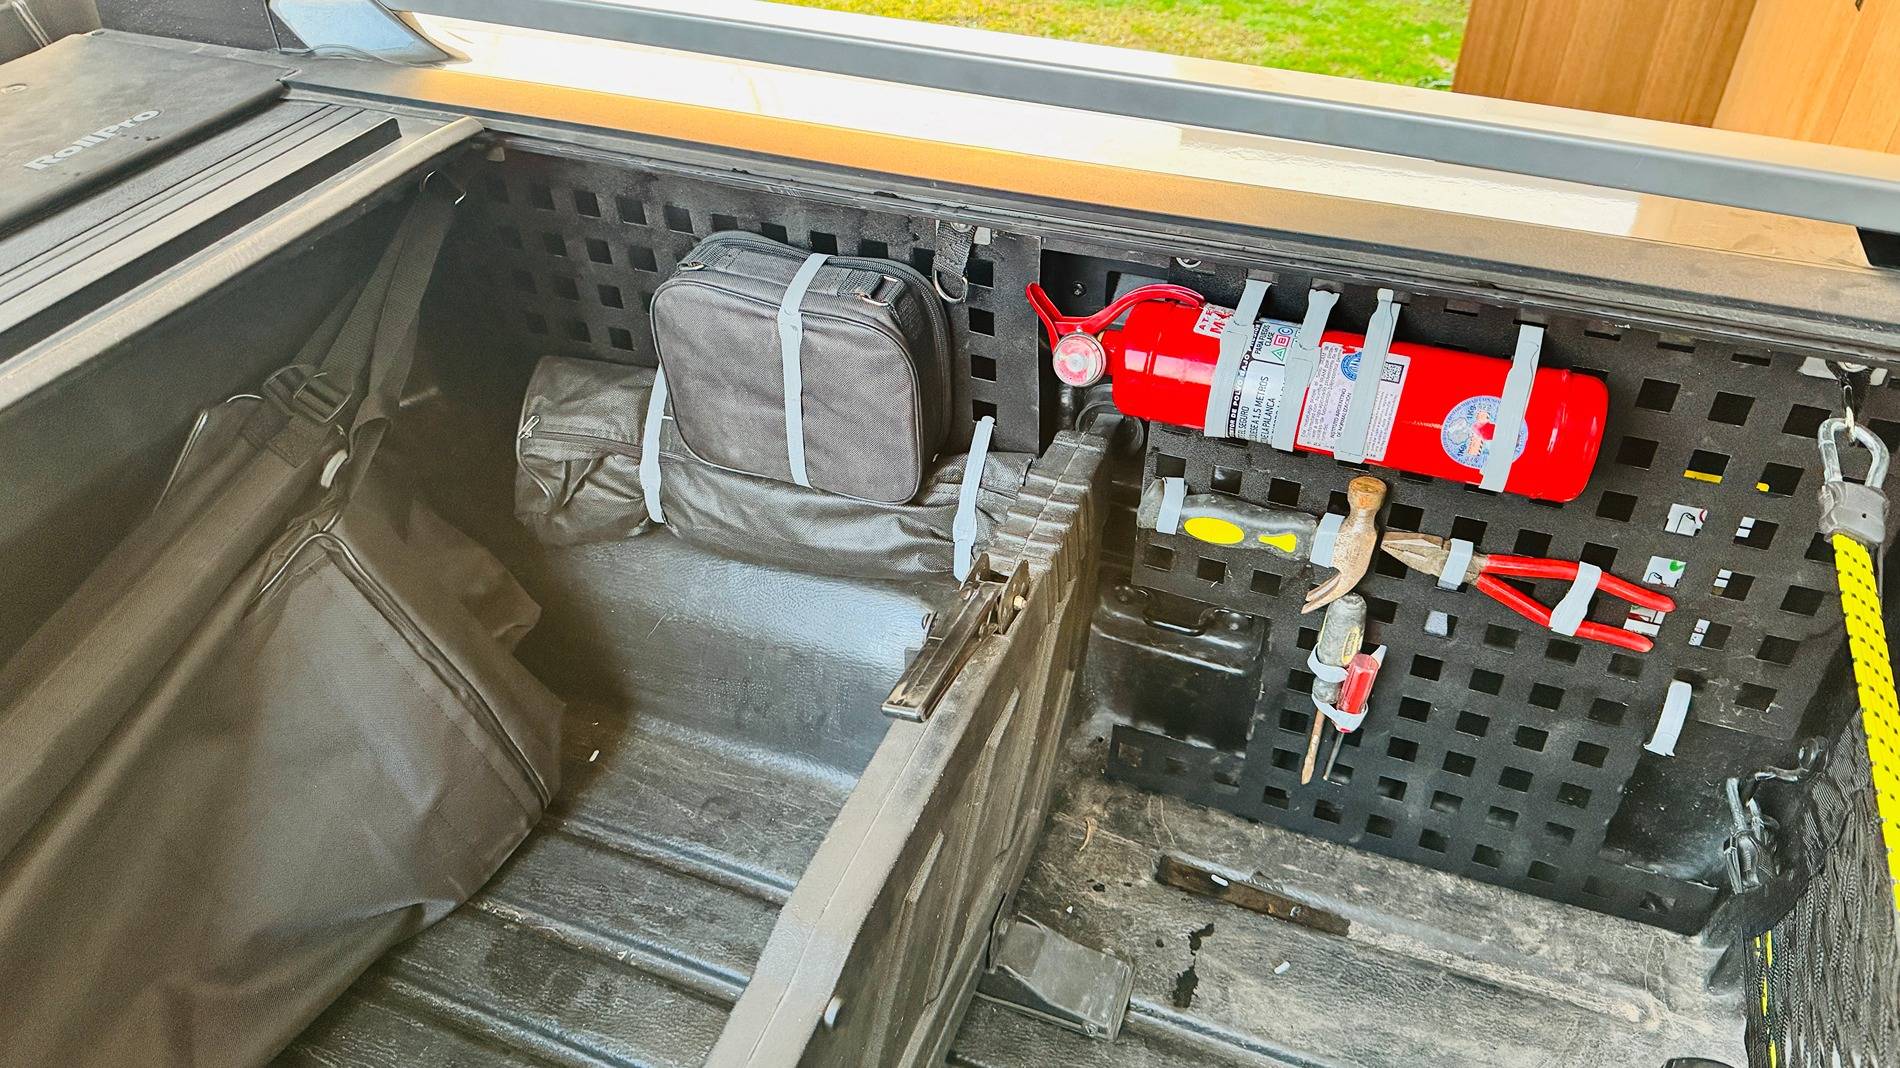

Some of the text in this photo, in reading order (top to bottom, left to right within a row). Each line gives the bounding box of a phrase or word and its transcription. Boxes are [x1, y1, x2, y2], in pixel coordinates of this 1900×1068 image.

[23, 109, 162, 171] RollPro
[1233, 379, 1243, 405] POLVO
[1240, 354, 1249, 376] BAJO
[1255, 375, 1269, 407] METROS
[1238, 406, 1249, 429] SEGURO
[1262, 397, 1275, 428] PALANCA
